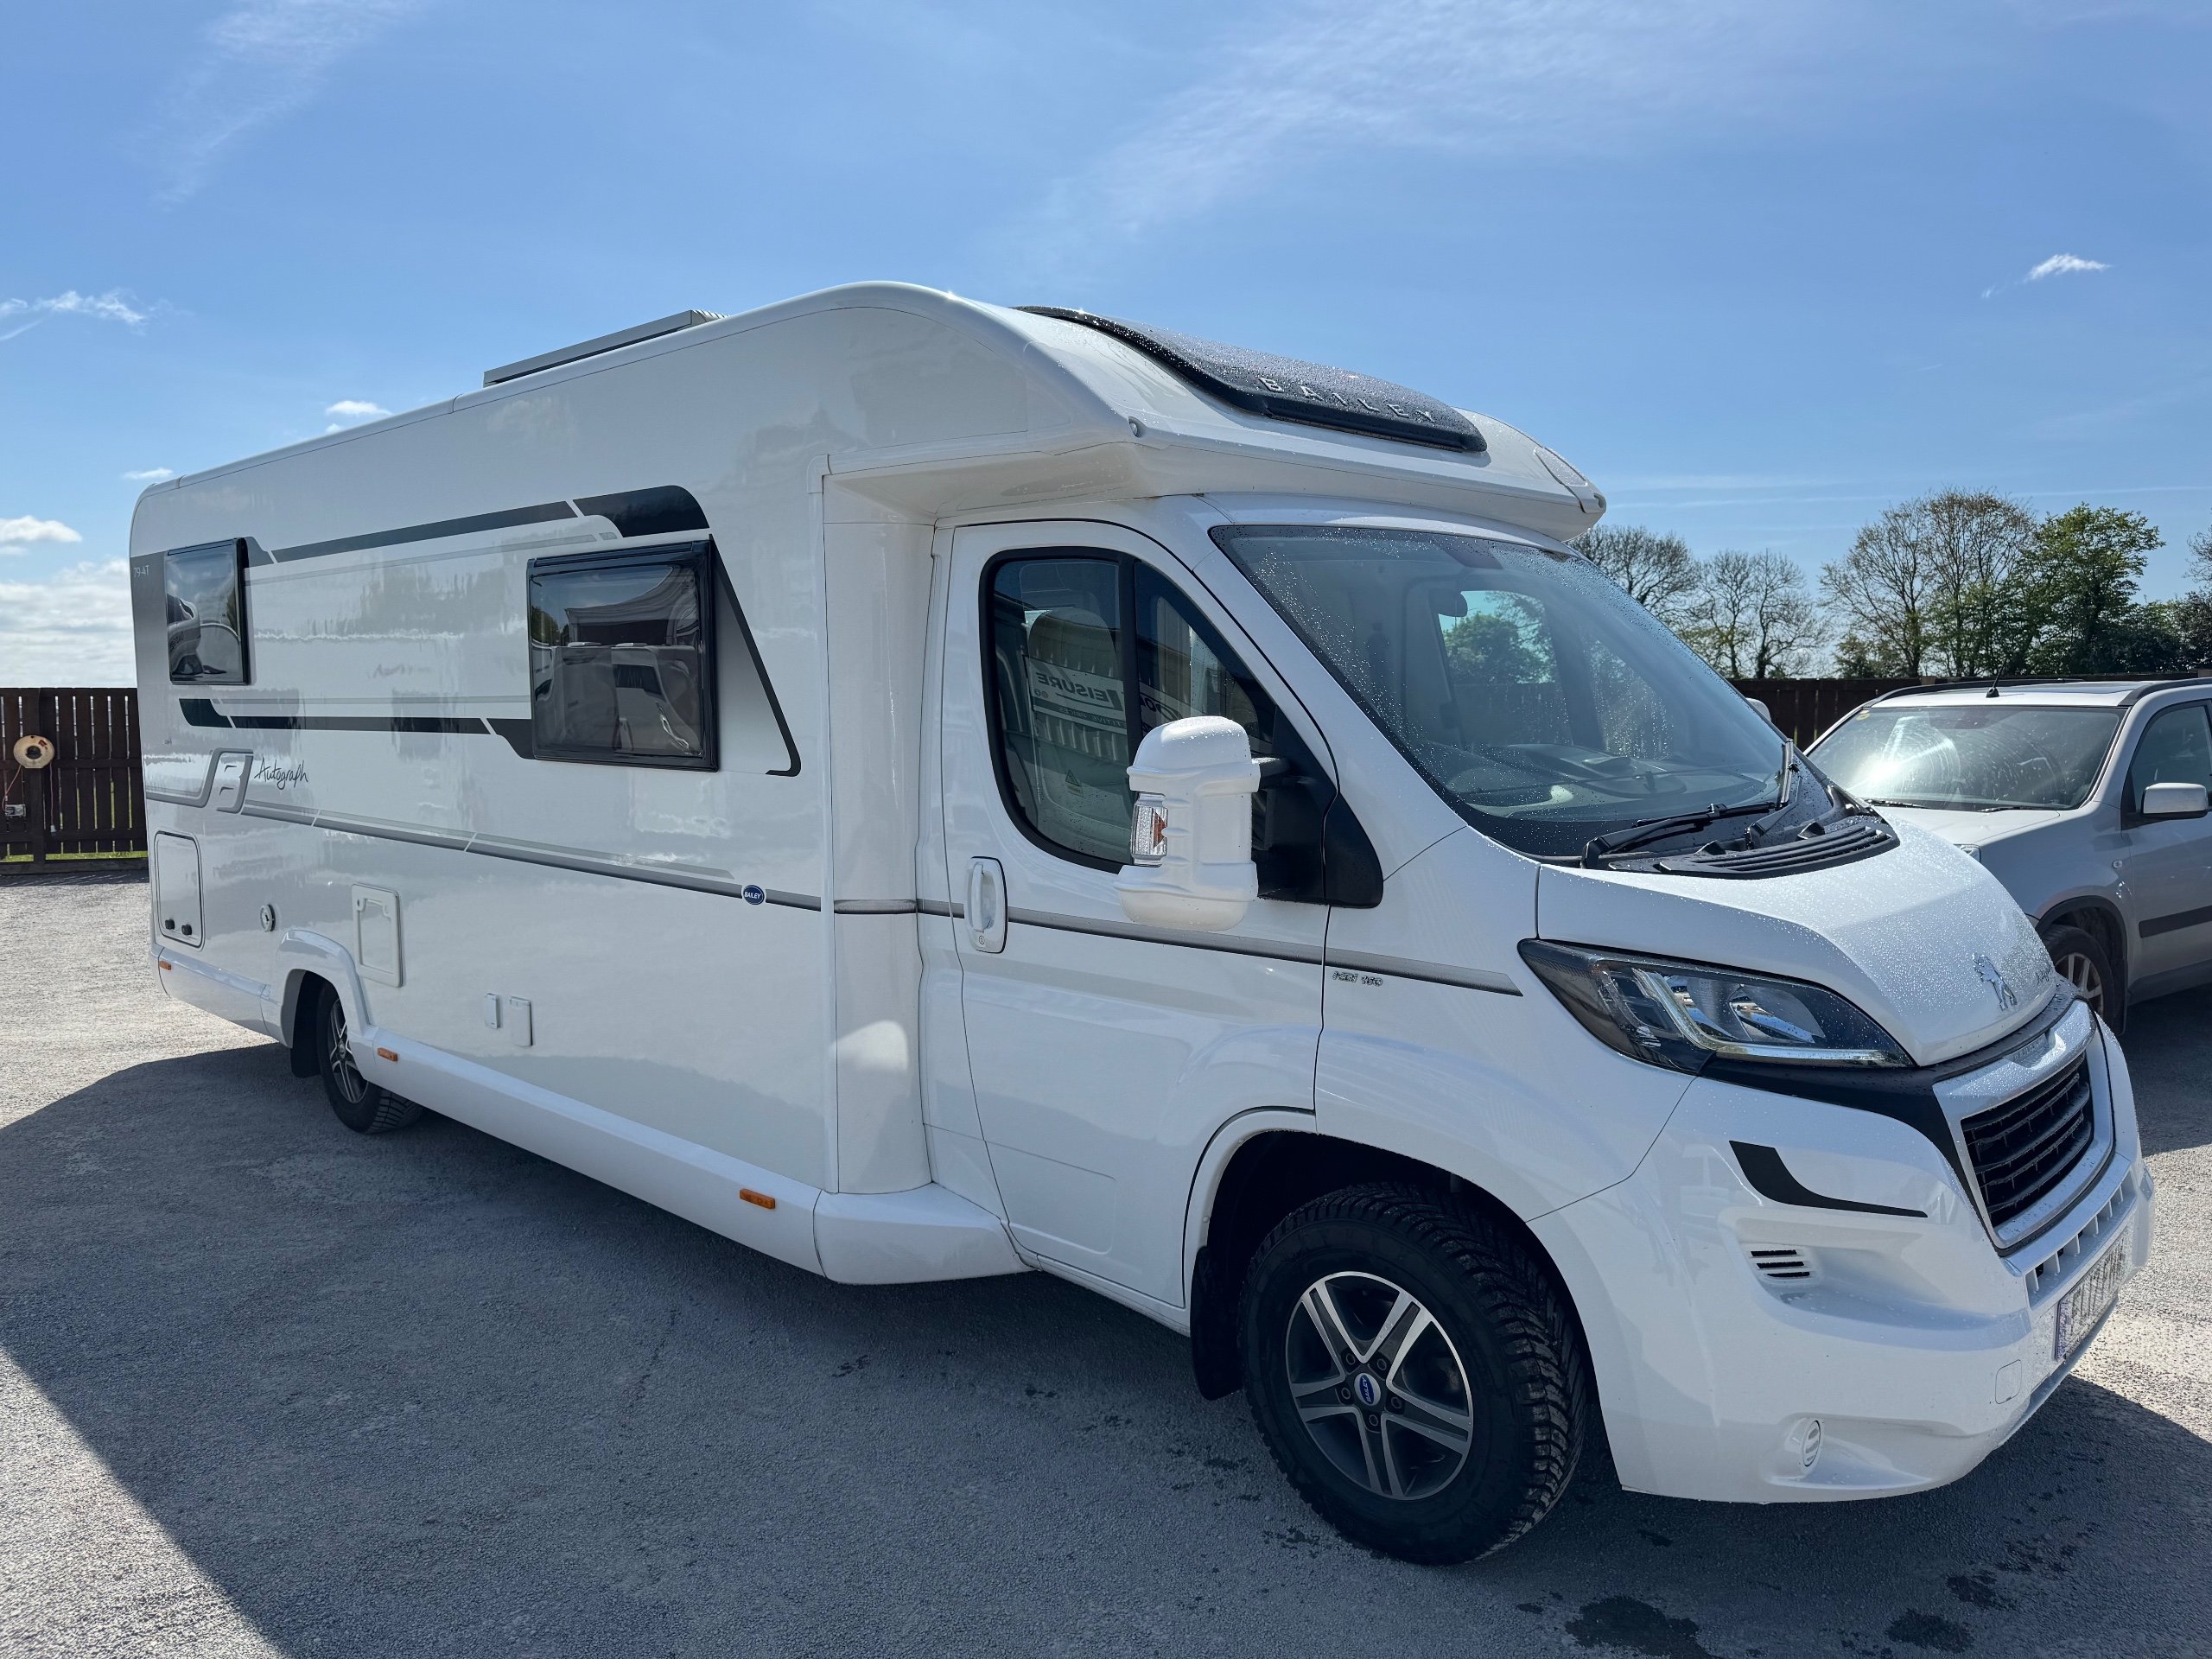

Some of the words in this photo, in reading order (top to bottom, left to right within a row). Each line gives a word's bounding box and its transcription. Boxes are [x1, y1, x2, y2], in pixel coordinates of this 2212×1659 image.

[1258, 377, 1435, 423] BAILEY
[253, 756, 308, 791] Autograph
[744, 891, 761, 899] BAILEY
